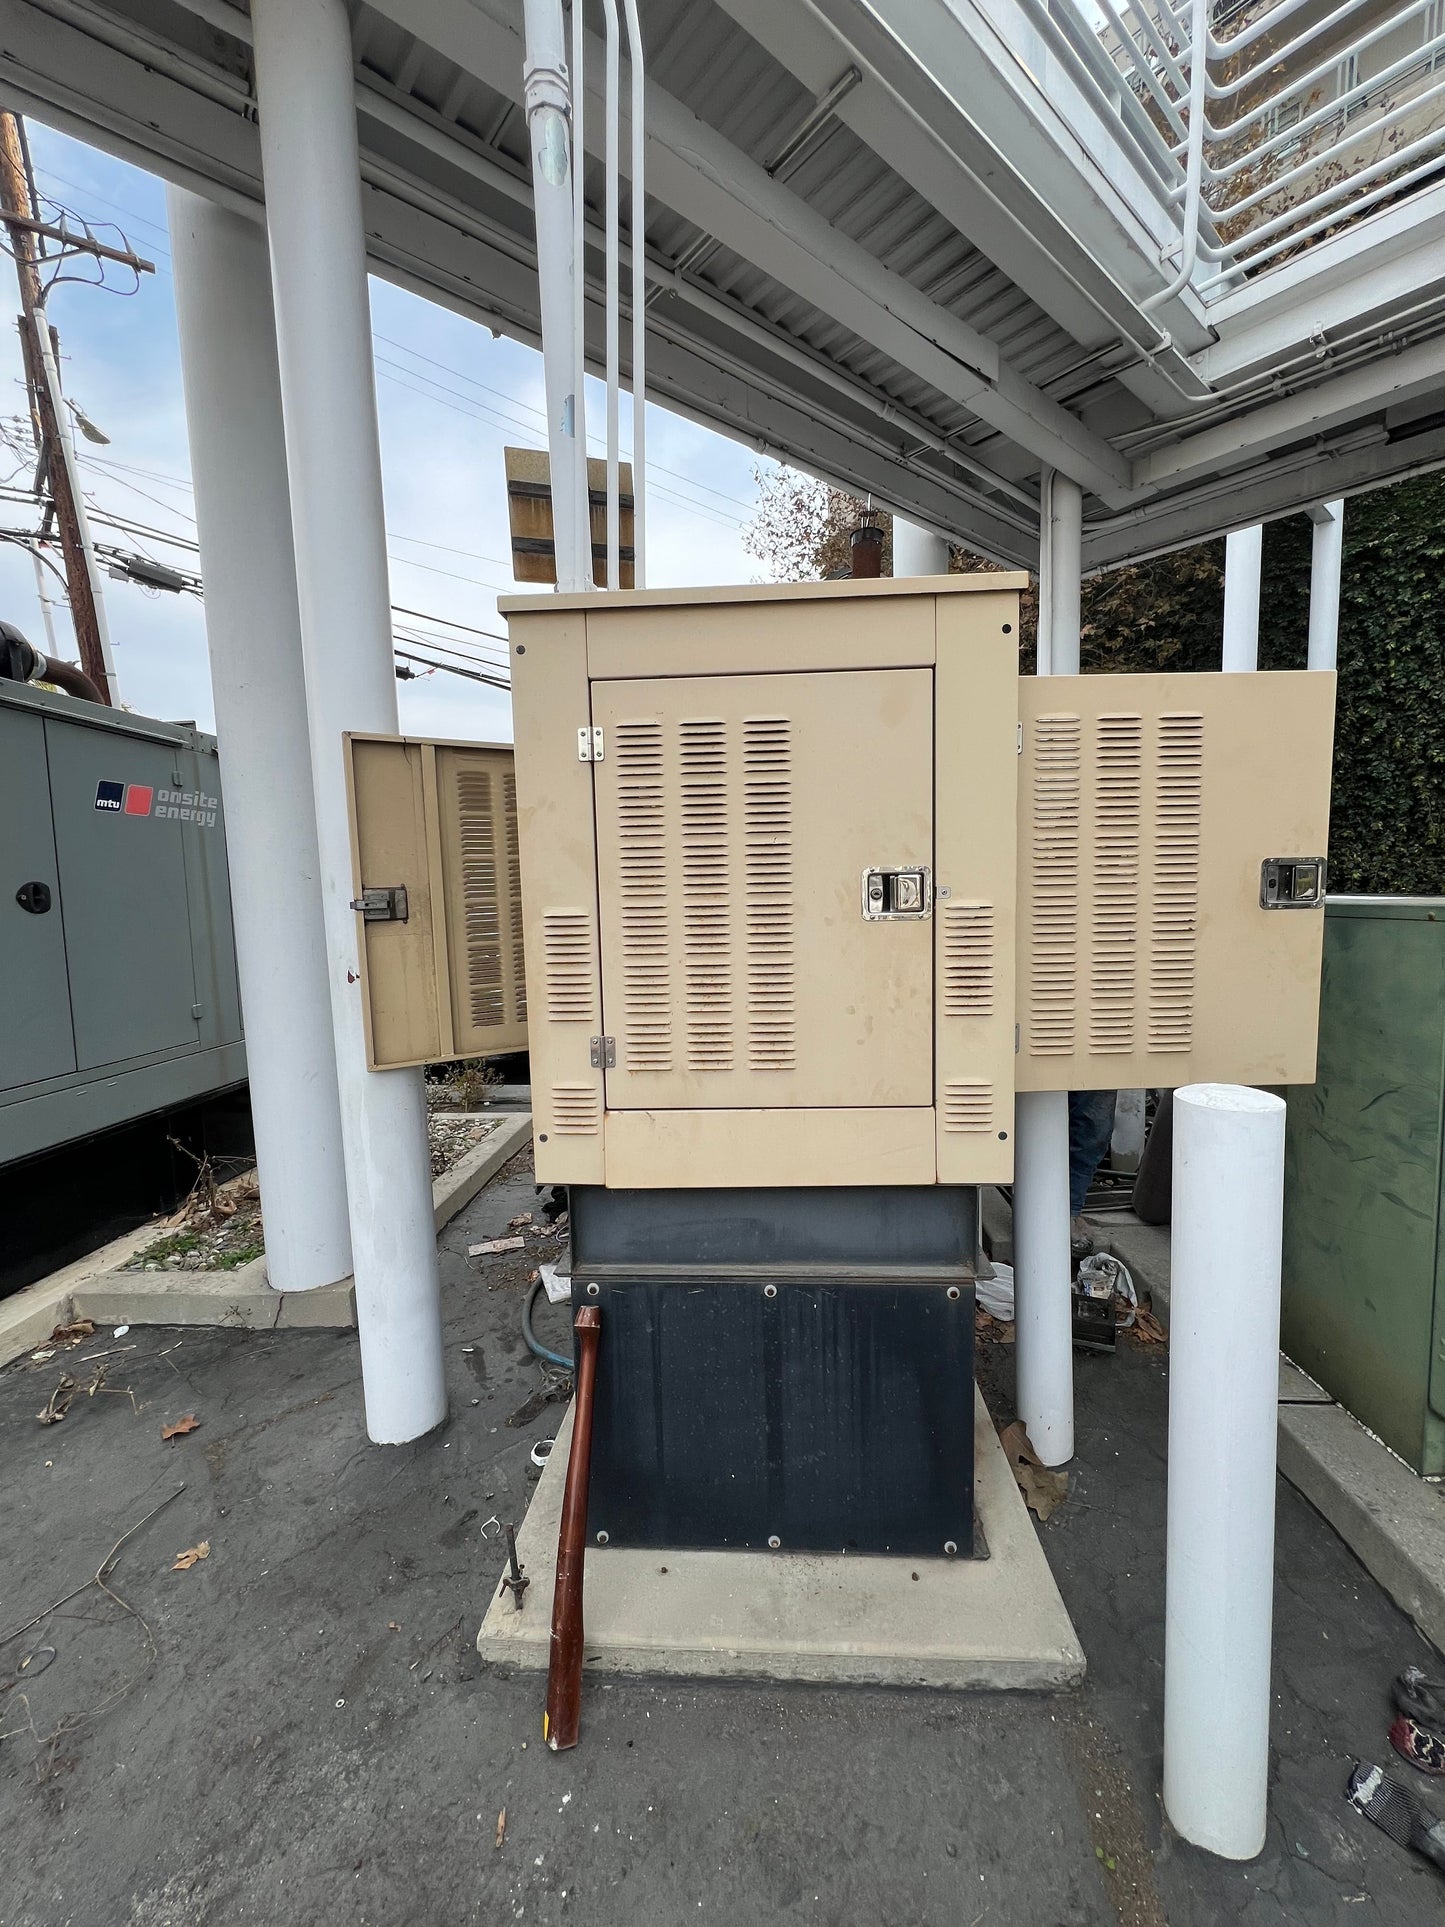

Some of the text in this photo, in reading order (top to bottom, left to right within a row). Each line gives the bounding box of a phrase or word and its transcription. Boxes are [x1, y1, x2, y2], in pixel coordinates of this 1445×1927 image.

[97, 799, 120, 809] mtu
[157, 790, 218, 809] onsite
[155, 805, 217, 828] energy
